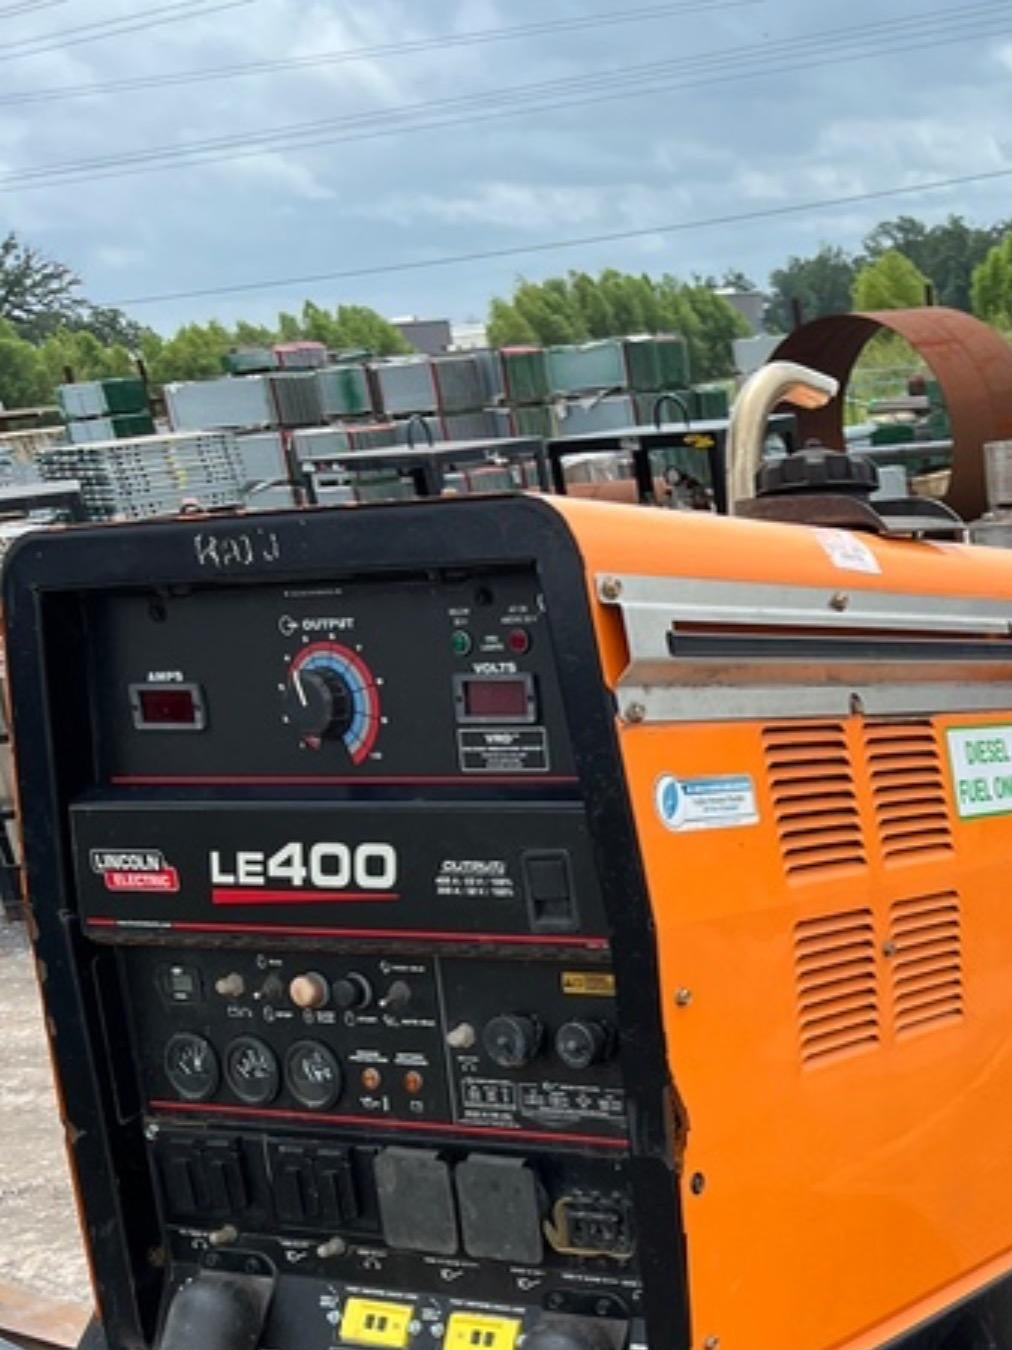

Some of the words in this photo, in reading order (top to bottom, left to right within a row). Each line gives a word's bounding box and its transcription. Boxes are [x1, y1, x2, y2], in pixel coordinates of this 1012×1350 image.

[965, 738, 1011, 766] DIESEL
[959, 778, 993, 805] FUEL
[95, 853, 160, 872] LINCOLN
[210, 841, 398, 890] LE400
